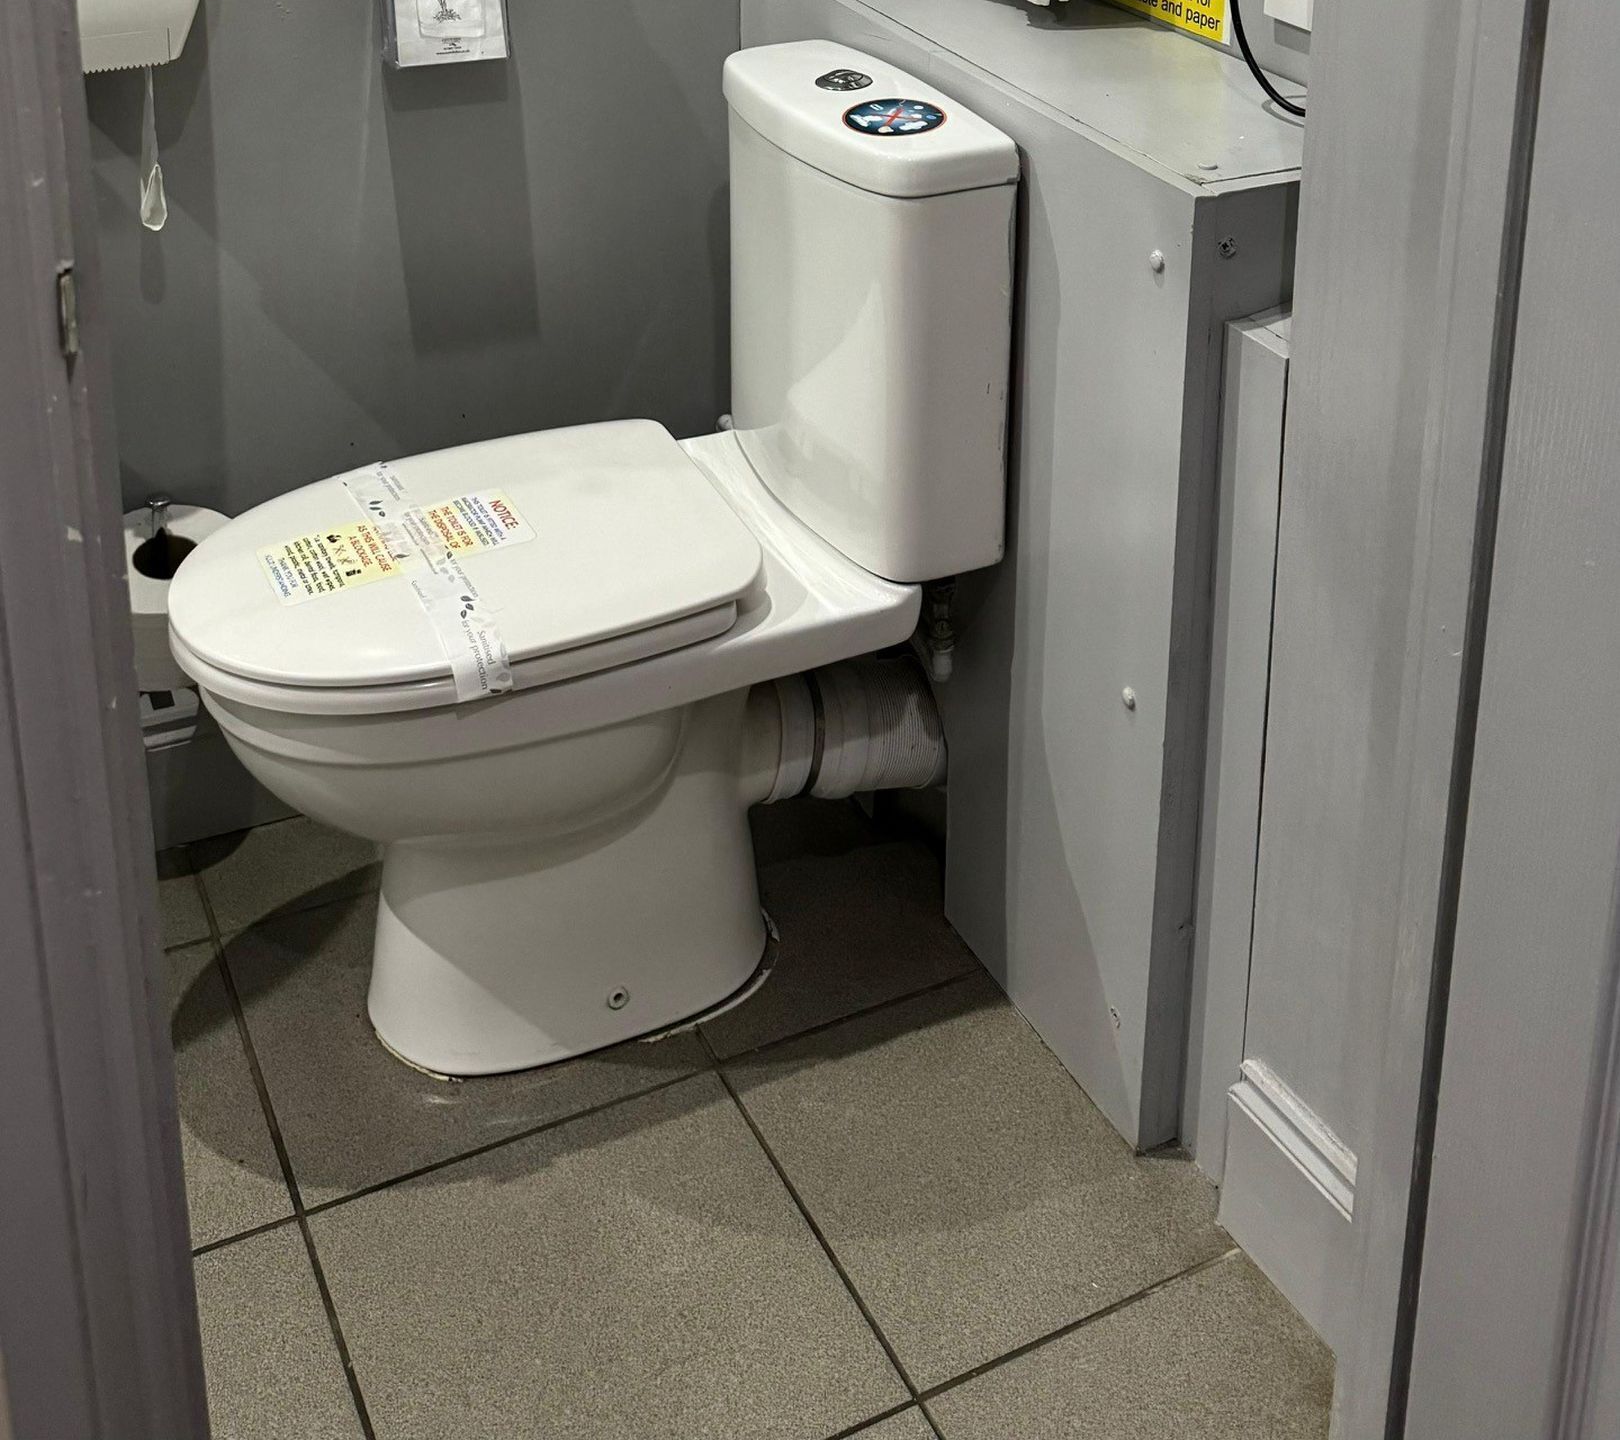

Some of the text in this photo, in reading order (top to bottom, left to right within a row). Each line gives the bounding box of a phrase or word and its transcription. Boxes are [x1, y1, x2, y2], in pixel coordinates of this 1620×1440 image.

[1162, 0, 1182, 17] and
[1186, 8, 1220, 31] paper
[428, 510, 440, 519] THE
[434, 519, 454, 541] DISPOSAL
[441, 506, 452, 516] THE
[447, 515, 463, 530] TOILET
[461, 535, 473, 546] FOR
[477, 504, 487, 514] TOILET
[487, 518, 497, 528] FITTED
[494, 528, 503, 537] WITH
[490, 500, 518, 529] NOTICE:
[317, 543, 328, 557] sanitary
[482, 525, 492, 536] WHICH
[490, 537, 499, 545] WILL
[278, 557, 289, 570] THANK
[294, 541, 304, 553] kitchen
[304, 561, 314, 572] dental
[309, 549, 319, 560] cotton
[362, 532, 374, 543] THIS
[368, 542, 380, 554] WILL
[375, 554, 392, 571] CAUSE
[297, 568, 306, 579] metal
[461, 620, 488, 690] for your protection
[478, 630, 496, 665] Sanitised
